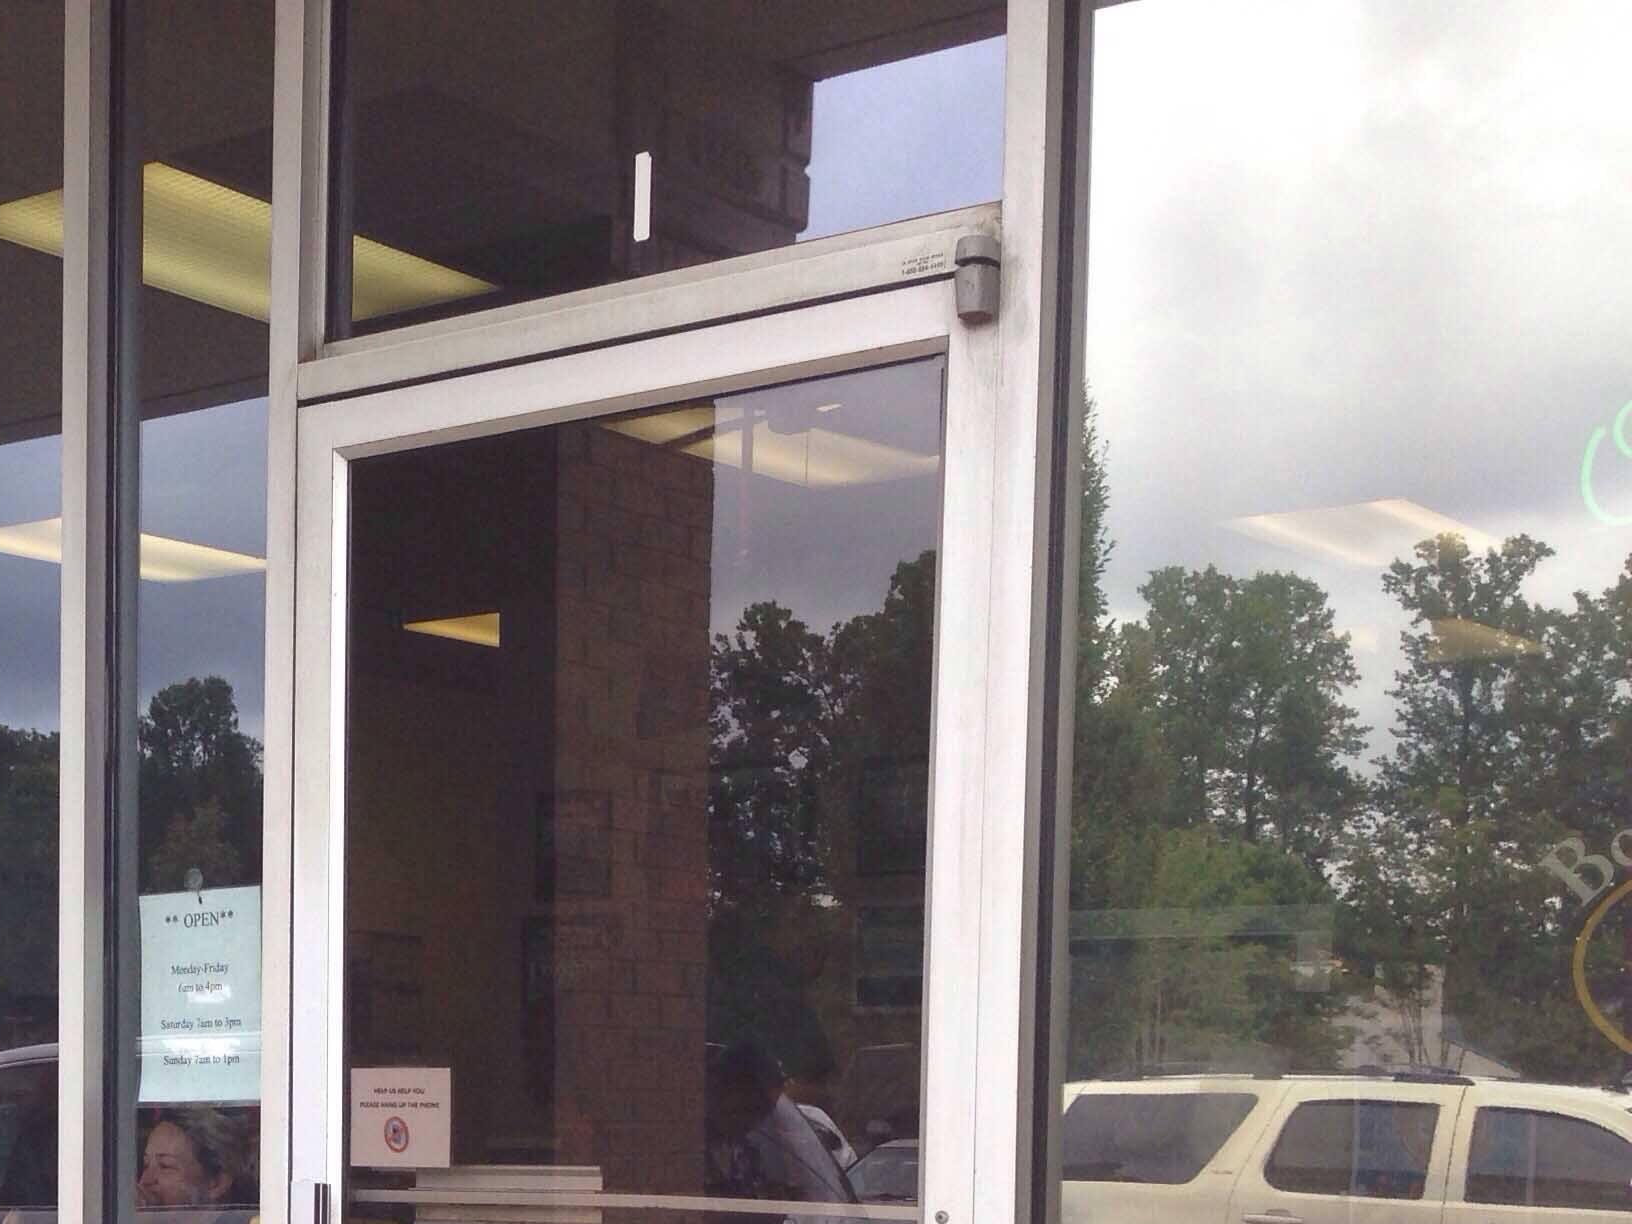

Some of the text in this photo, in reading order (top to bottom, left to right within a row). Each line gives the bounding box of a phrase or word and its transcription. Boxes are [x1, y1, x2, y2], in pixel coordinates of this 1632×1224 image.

[195, 981, 204, 993] to
[205, 980, 223, 994] 4pm
[160, 1018, 194, 1031] Saturday
[214, 1017, 223, 1029] to
[163, 1054, 192, 1066] Sunday
[212, 1054, 221, 1065] to
[223, 1053, 240, 1067] 1pm
